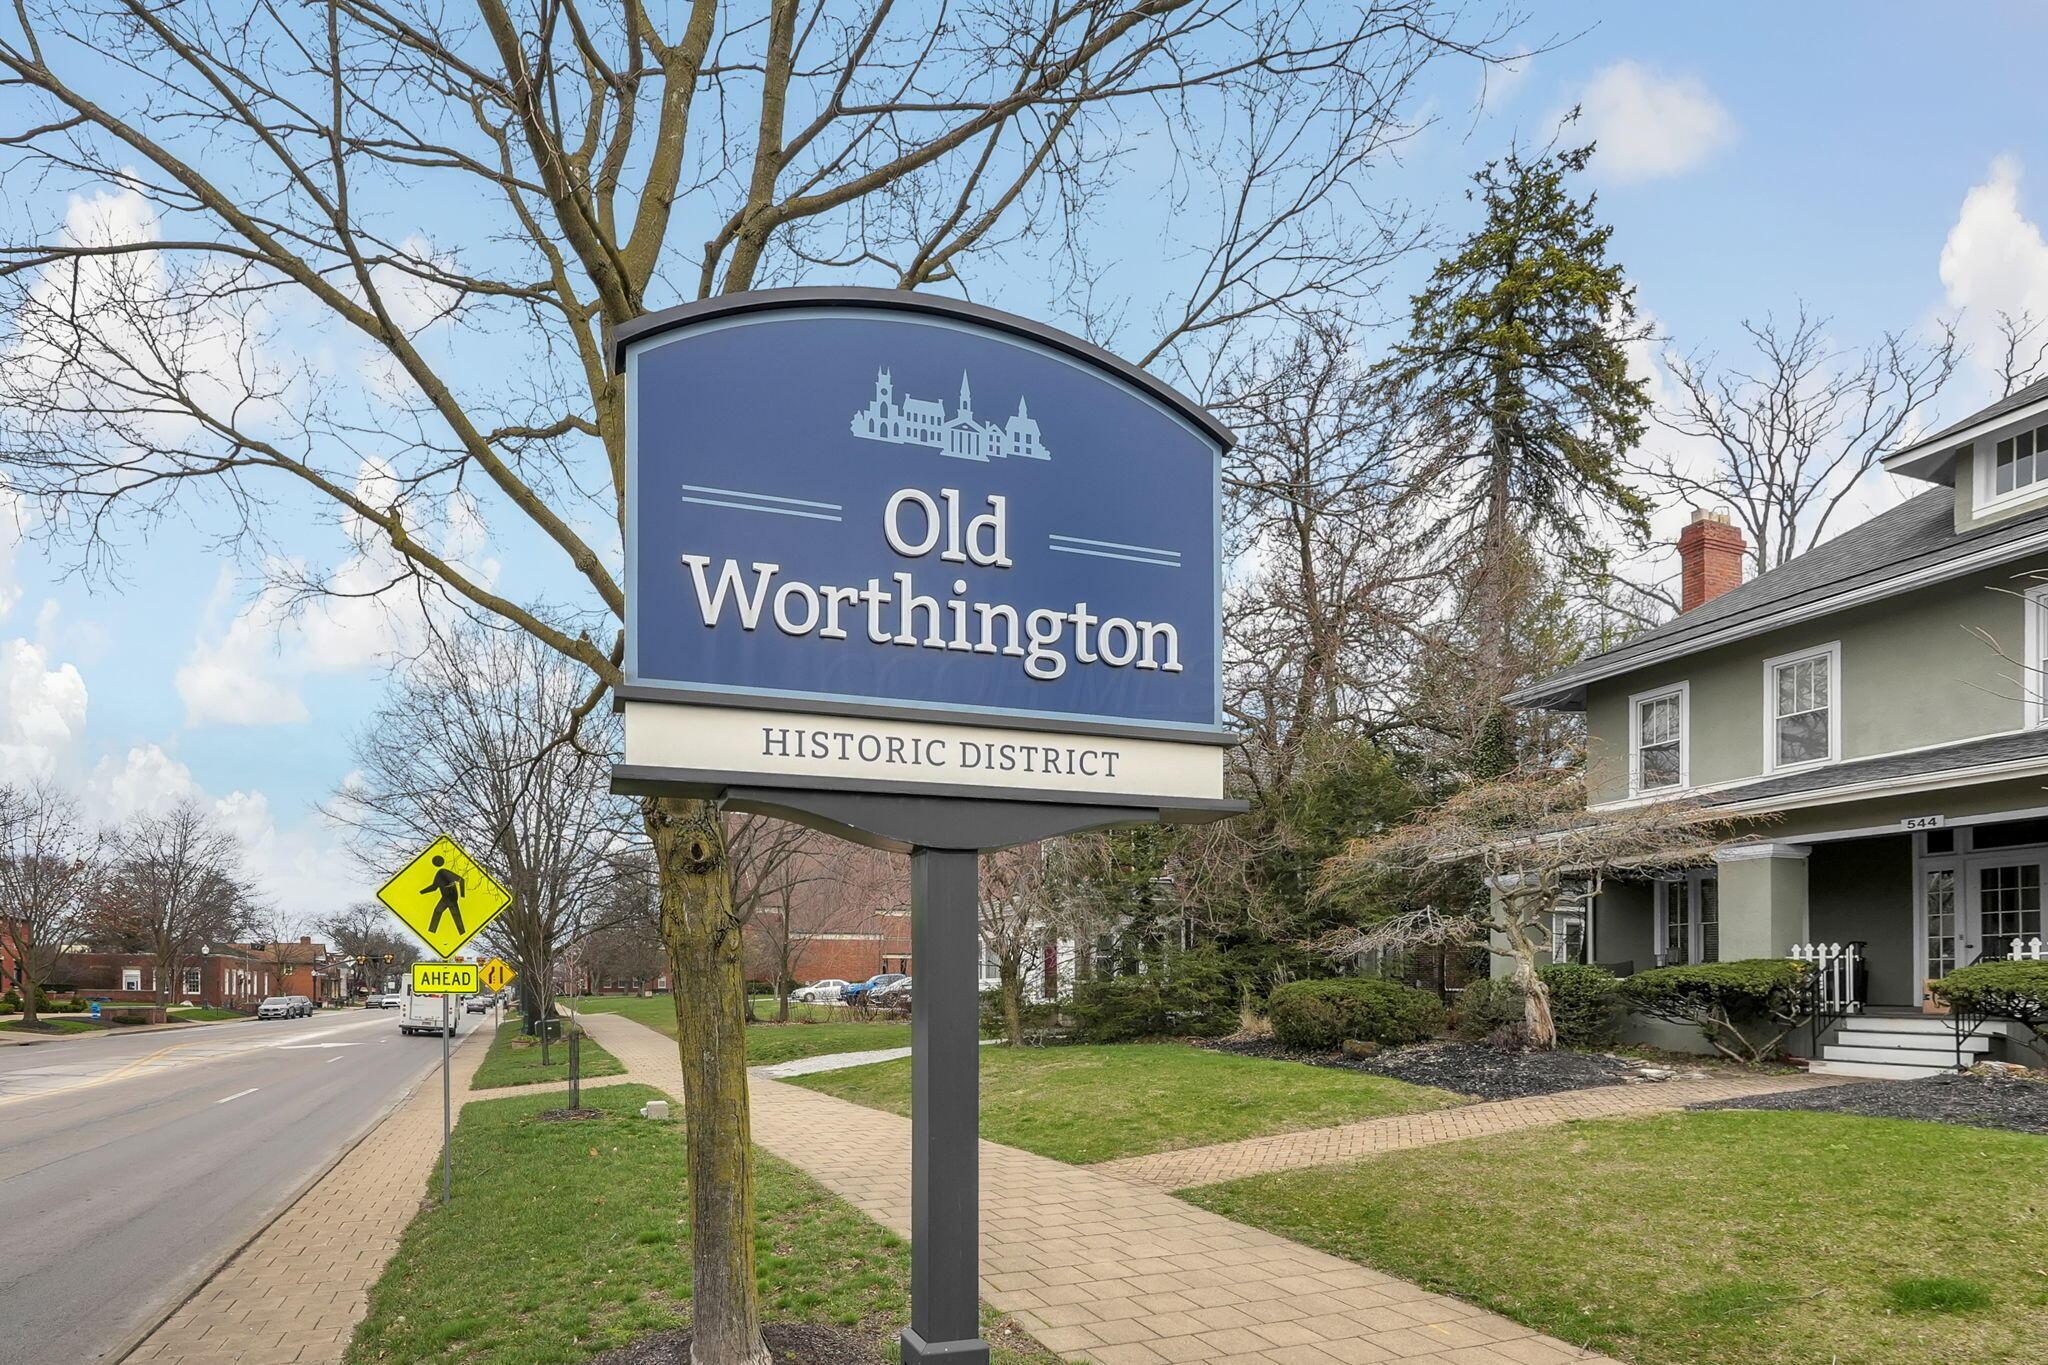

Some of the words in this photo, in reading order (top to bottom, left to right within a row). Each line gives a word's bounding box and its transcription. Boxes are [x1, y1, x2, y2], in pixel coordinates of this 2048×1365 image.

[884, 487, 1013, 569] Old
[680, 553, 1185, 681] Worthington
[762, 727, 947, 767] HISTORIC
[959, 741, 1121, 778] DISTRICT
[1907, 817, 1938, 829] 544
[421, 971, 472, 986] AHEAD
